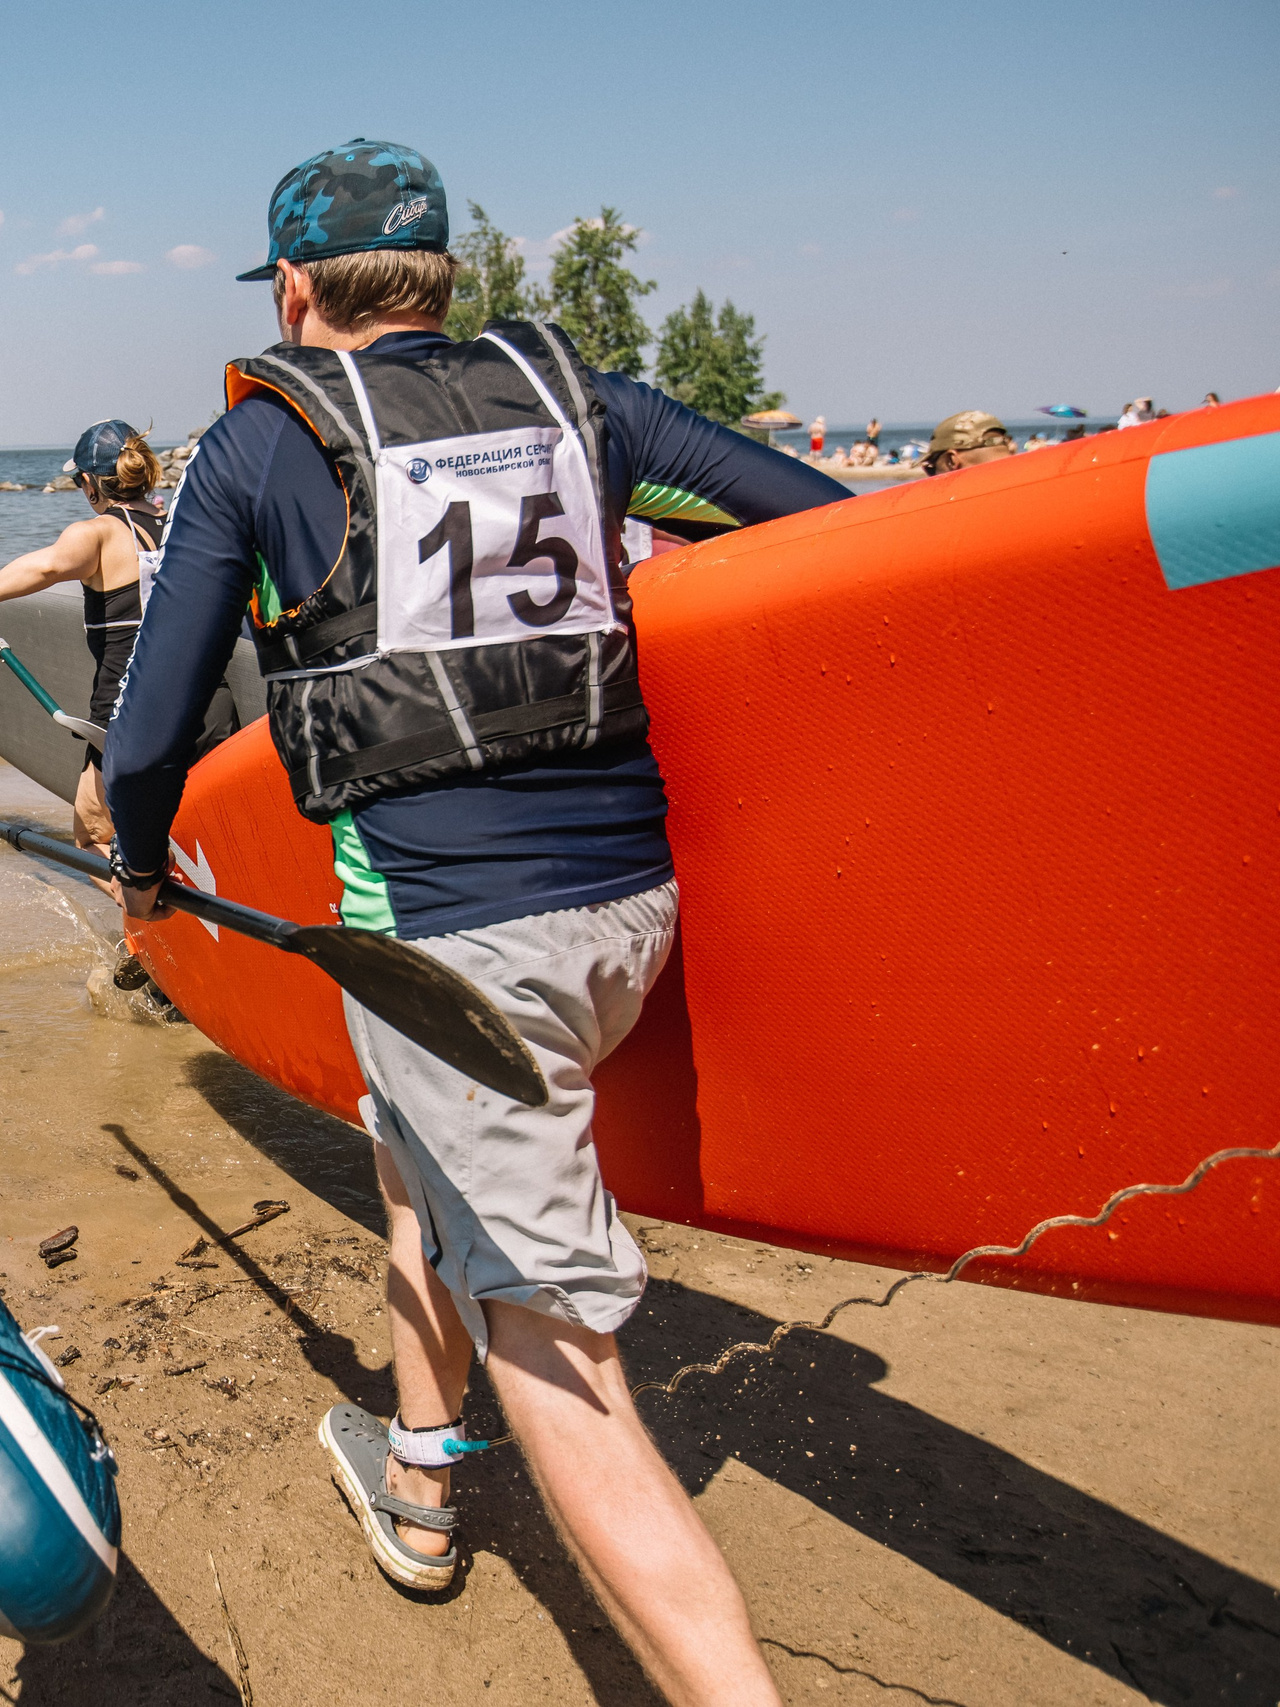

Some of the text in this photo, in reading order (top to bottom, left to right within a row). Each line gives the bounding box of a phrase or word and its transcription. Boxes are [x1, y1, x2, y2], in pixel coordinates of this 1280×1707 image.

[435, 447, 522, 470] ФЕДЕРАЦИЯ
[455, 458, 534, 478] НОВОСИБИРСКОЙ
[418, 491, 578, 640] 15
